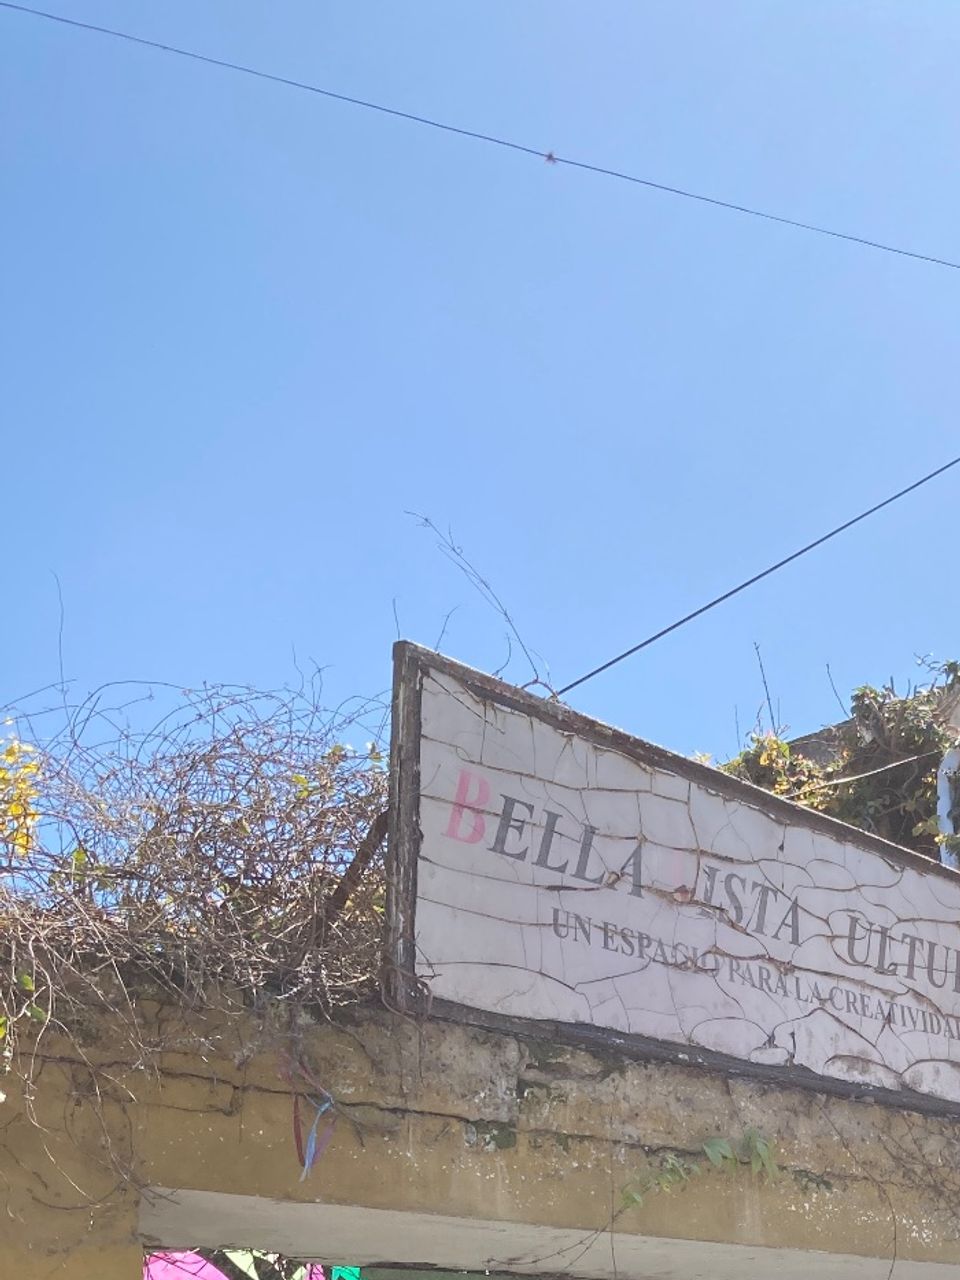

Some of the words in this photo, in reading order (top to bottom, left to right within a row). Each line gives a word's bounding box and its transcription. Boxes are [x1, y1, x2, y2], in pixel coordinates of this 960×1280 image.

[440, 770, 644, 898] BELLA
[697, 864, 803, 946] ISTA
[551, 908, 593, 946] UN
[602, 920, 721, 978] ESPACIO
[728, 957, 788, 1002] PARA
[794, 975, 826, 1005] LA
